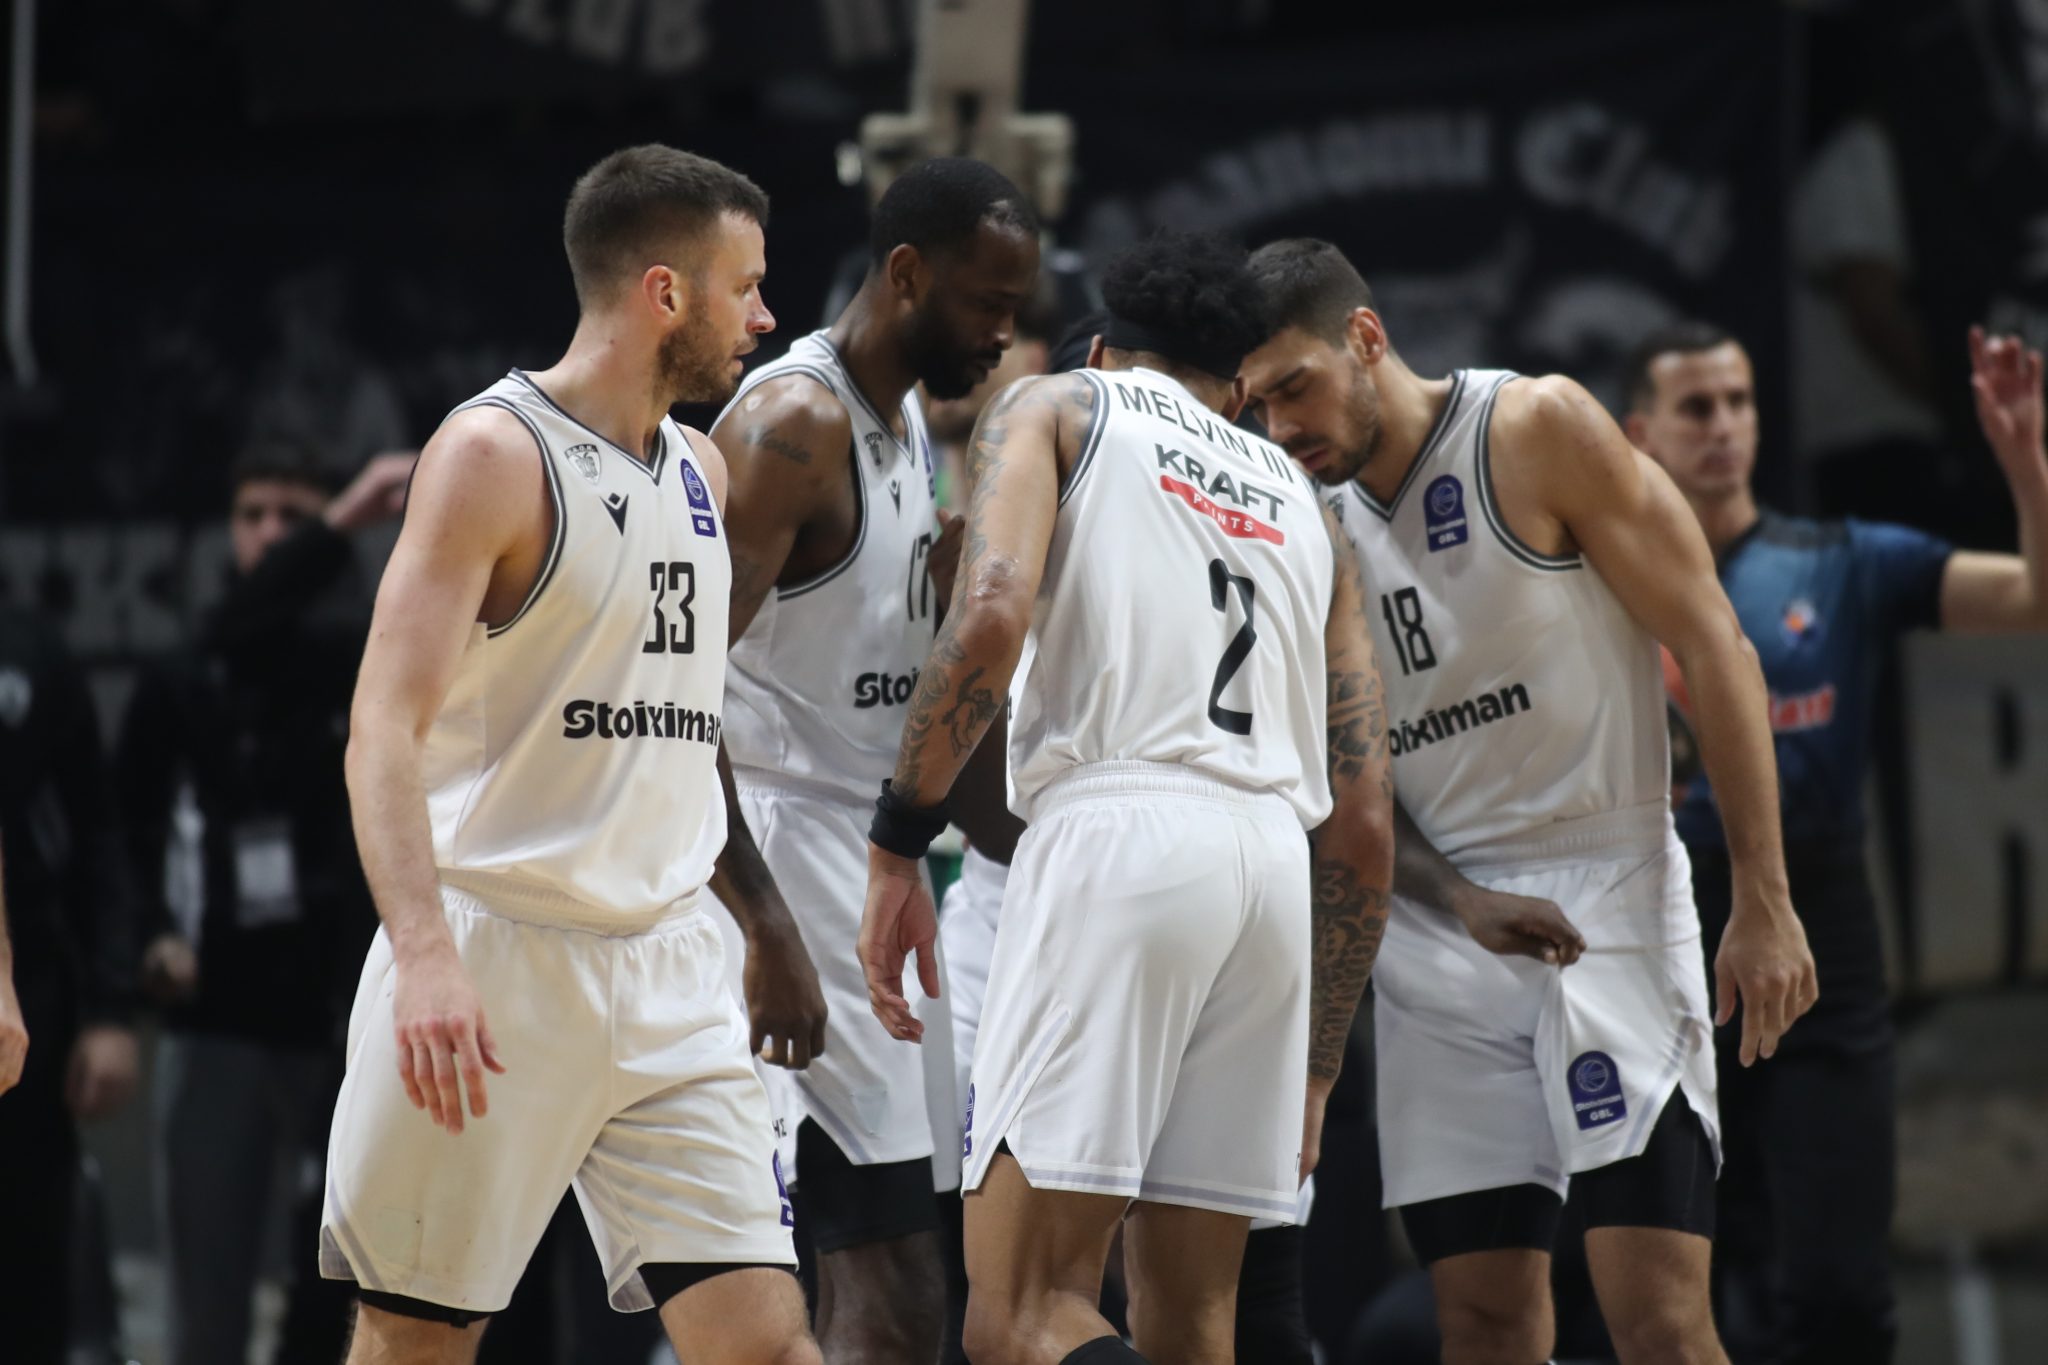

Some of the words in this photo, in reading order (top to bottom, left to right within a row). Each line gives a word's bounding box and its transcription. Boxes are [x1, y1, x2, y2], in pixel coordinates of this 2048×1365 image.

[1114, 382, 1255, 463] MELVIN
[1258, 443, 1295, 484] III
[1154, 442, 1285, 523] KRAFT
[1192, 492, 1254, 532] PAINTS
[642, 561, 695, 654] 33
[907, 531, 932, 622] 17
[1207, 558, 1257, 735] 2
[1381, 585, 1437, 676] 18
[1388, 683, 1531, 757] oiximan
